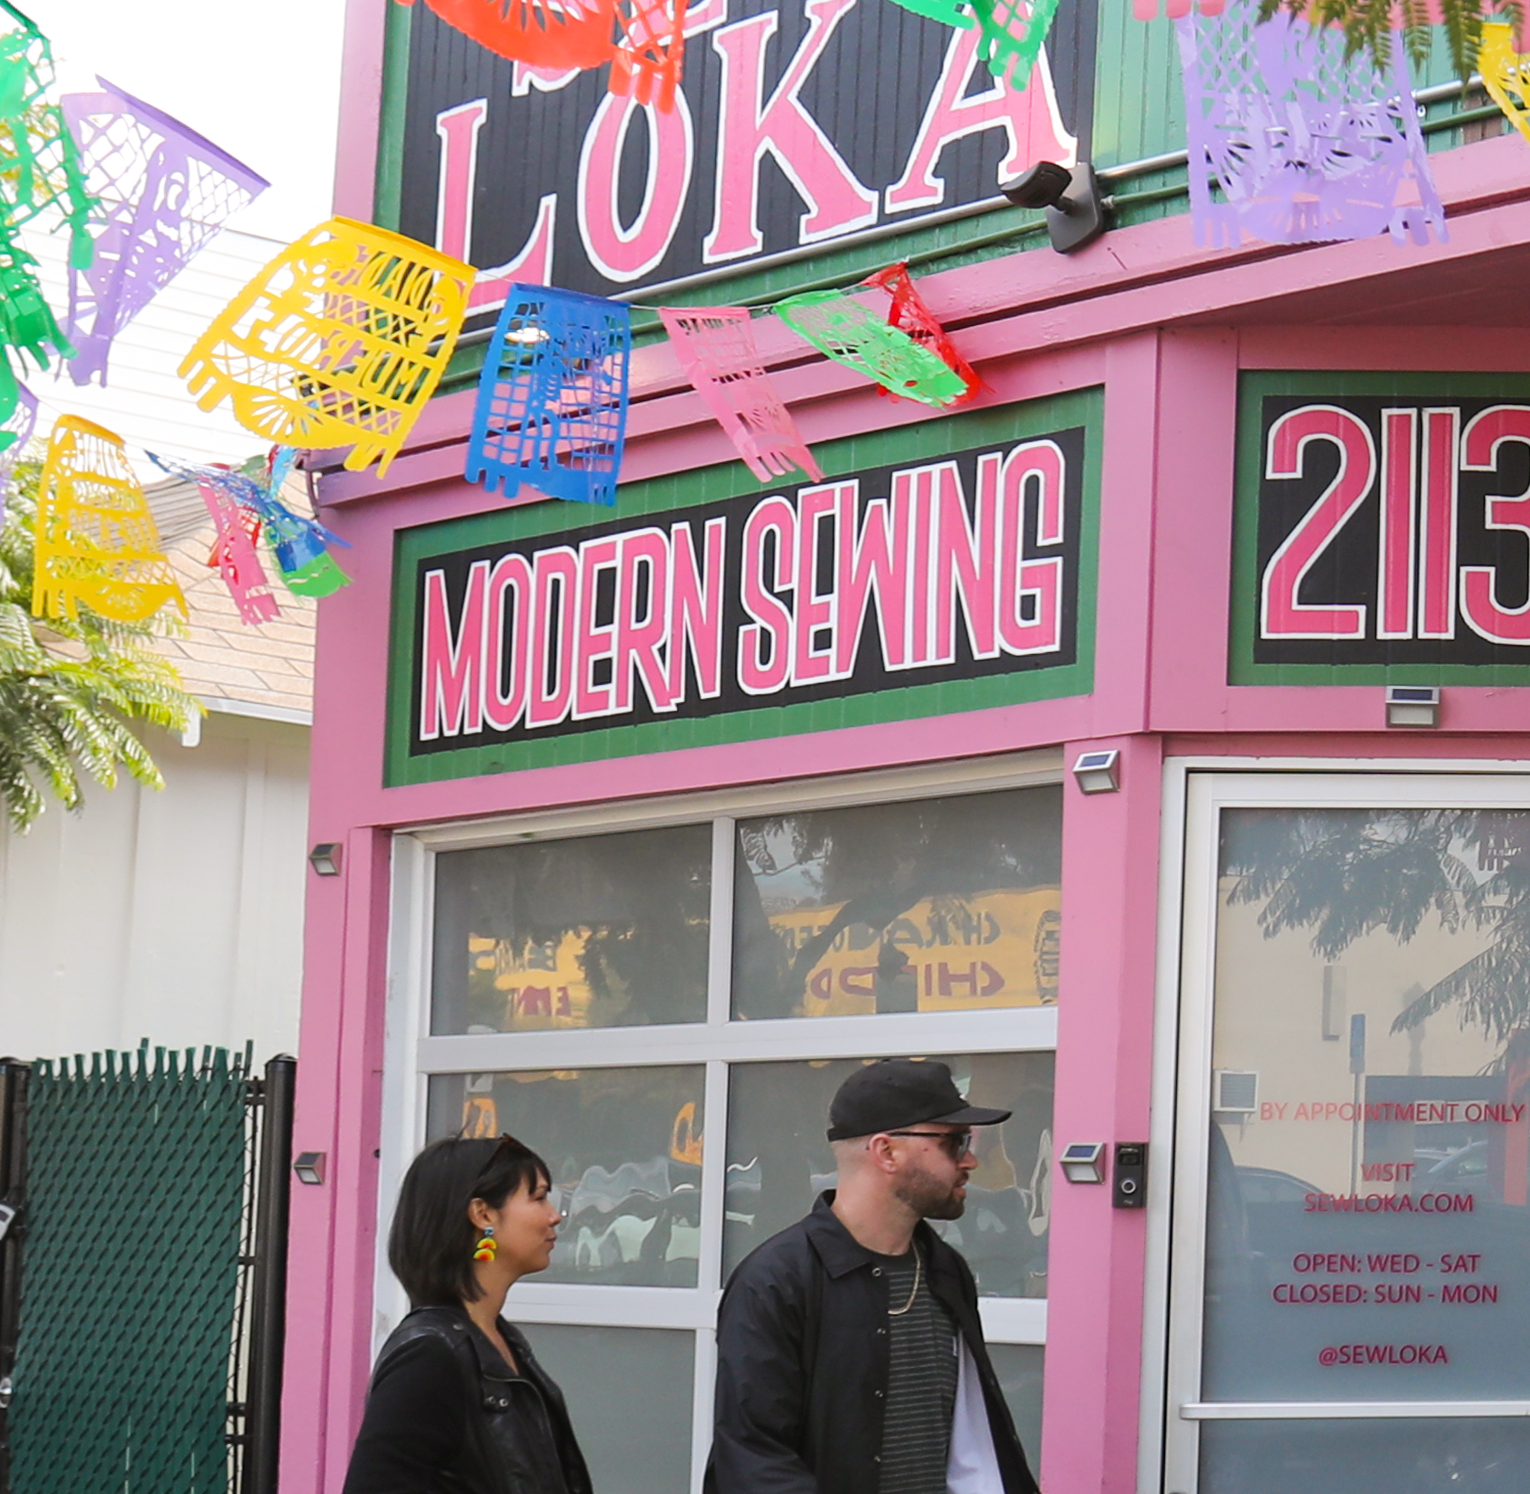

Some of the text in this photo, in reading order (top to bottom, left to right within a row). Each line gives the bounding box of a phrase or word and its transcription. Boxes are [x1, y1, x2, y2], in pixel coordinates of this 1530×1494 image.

[417, 439, 1066, 740] MODERN SEWING
[1259, 1101, 1527, 1123] BY APPOINTMENT ONLY
[1360, 1162, 1416, 1183] VISIT
[1303, 1192, 1475, 1214] SEWLOKA.COM
[1292, 1253, 1363, 1274] OPEN:
[1366, 1253, 1420, 1274] WED
[1439, 1253, 1482, 1274] SAT
[1272, 1283, 1369, 1304] CLOSED:
[1373, 1283, 1422, 1304] SUN
[1441, 1283, 1499, 1304] MON
[1317, 1344, 1449, 1367] @SEWLOKA
